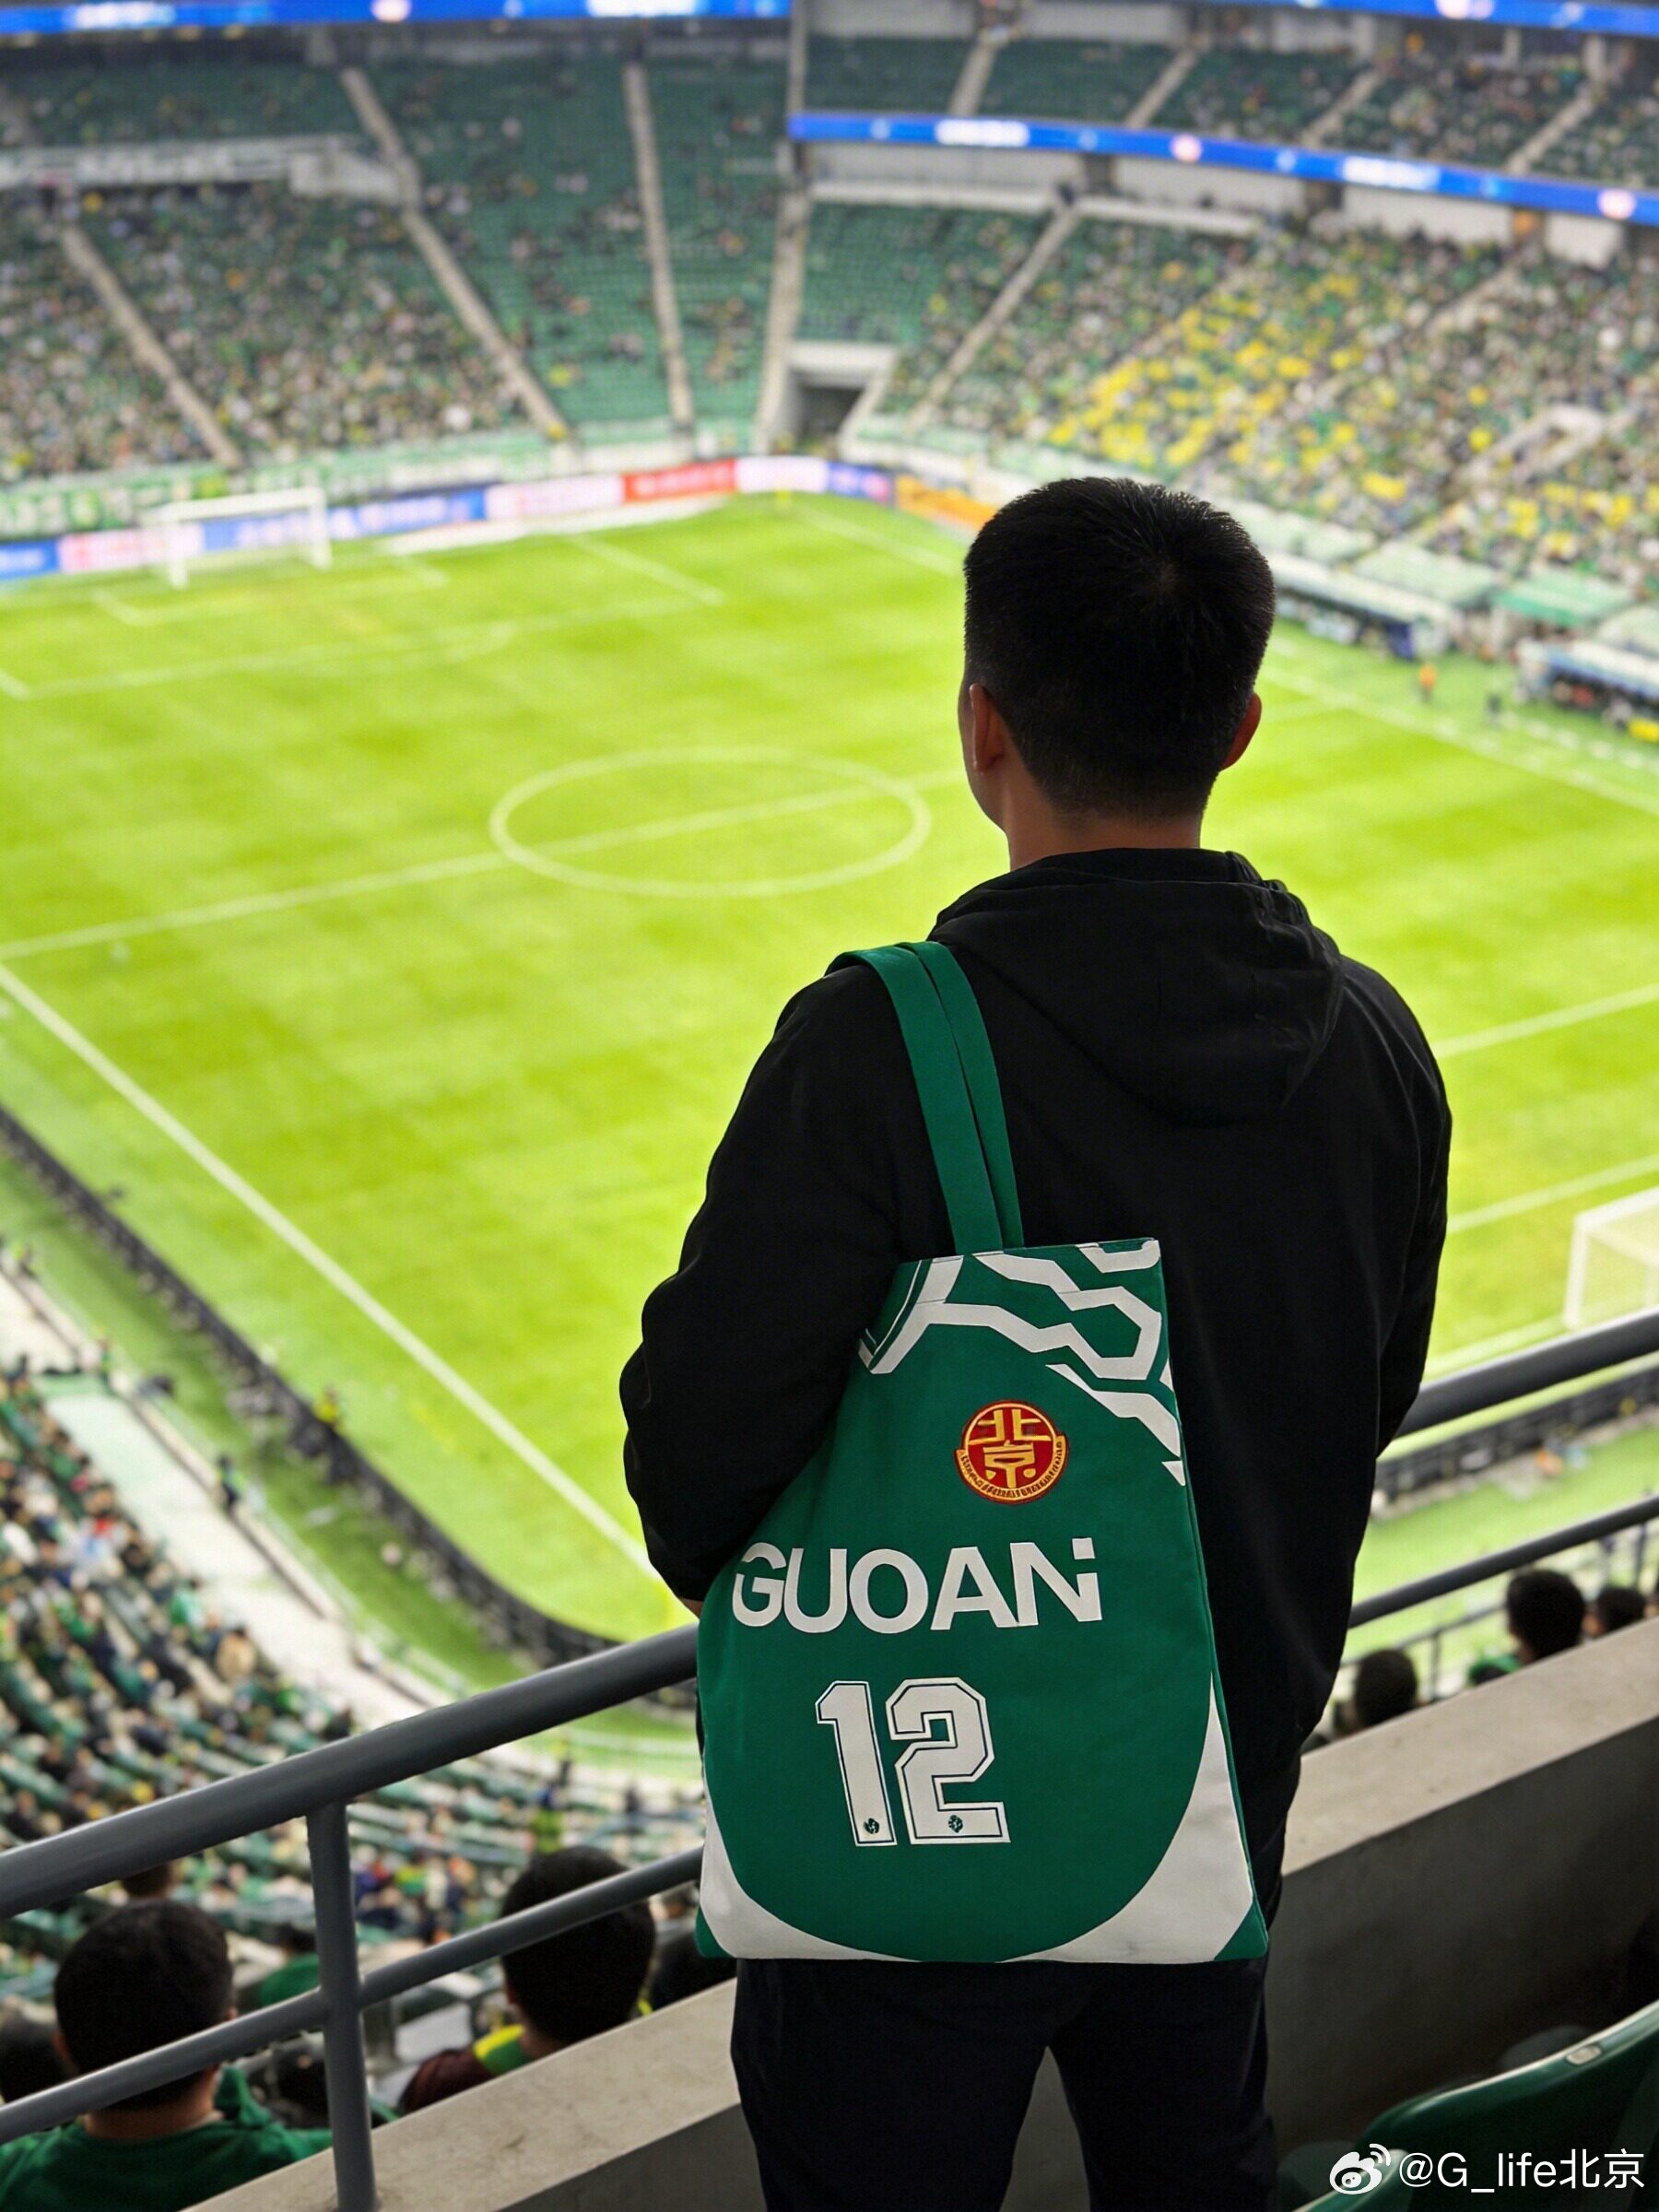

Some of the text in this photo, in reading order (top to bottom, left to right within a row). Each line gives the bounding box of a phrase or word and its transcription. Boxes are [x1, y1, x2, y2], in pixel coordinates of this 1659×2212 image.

[968, 1408, 1052, 1488] 北京
[732, 1537, 1103, 1634] GUOAN
[815, 1677, 1012, 1846] 12
